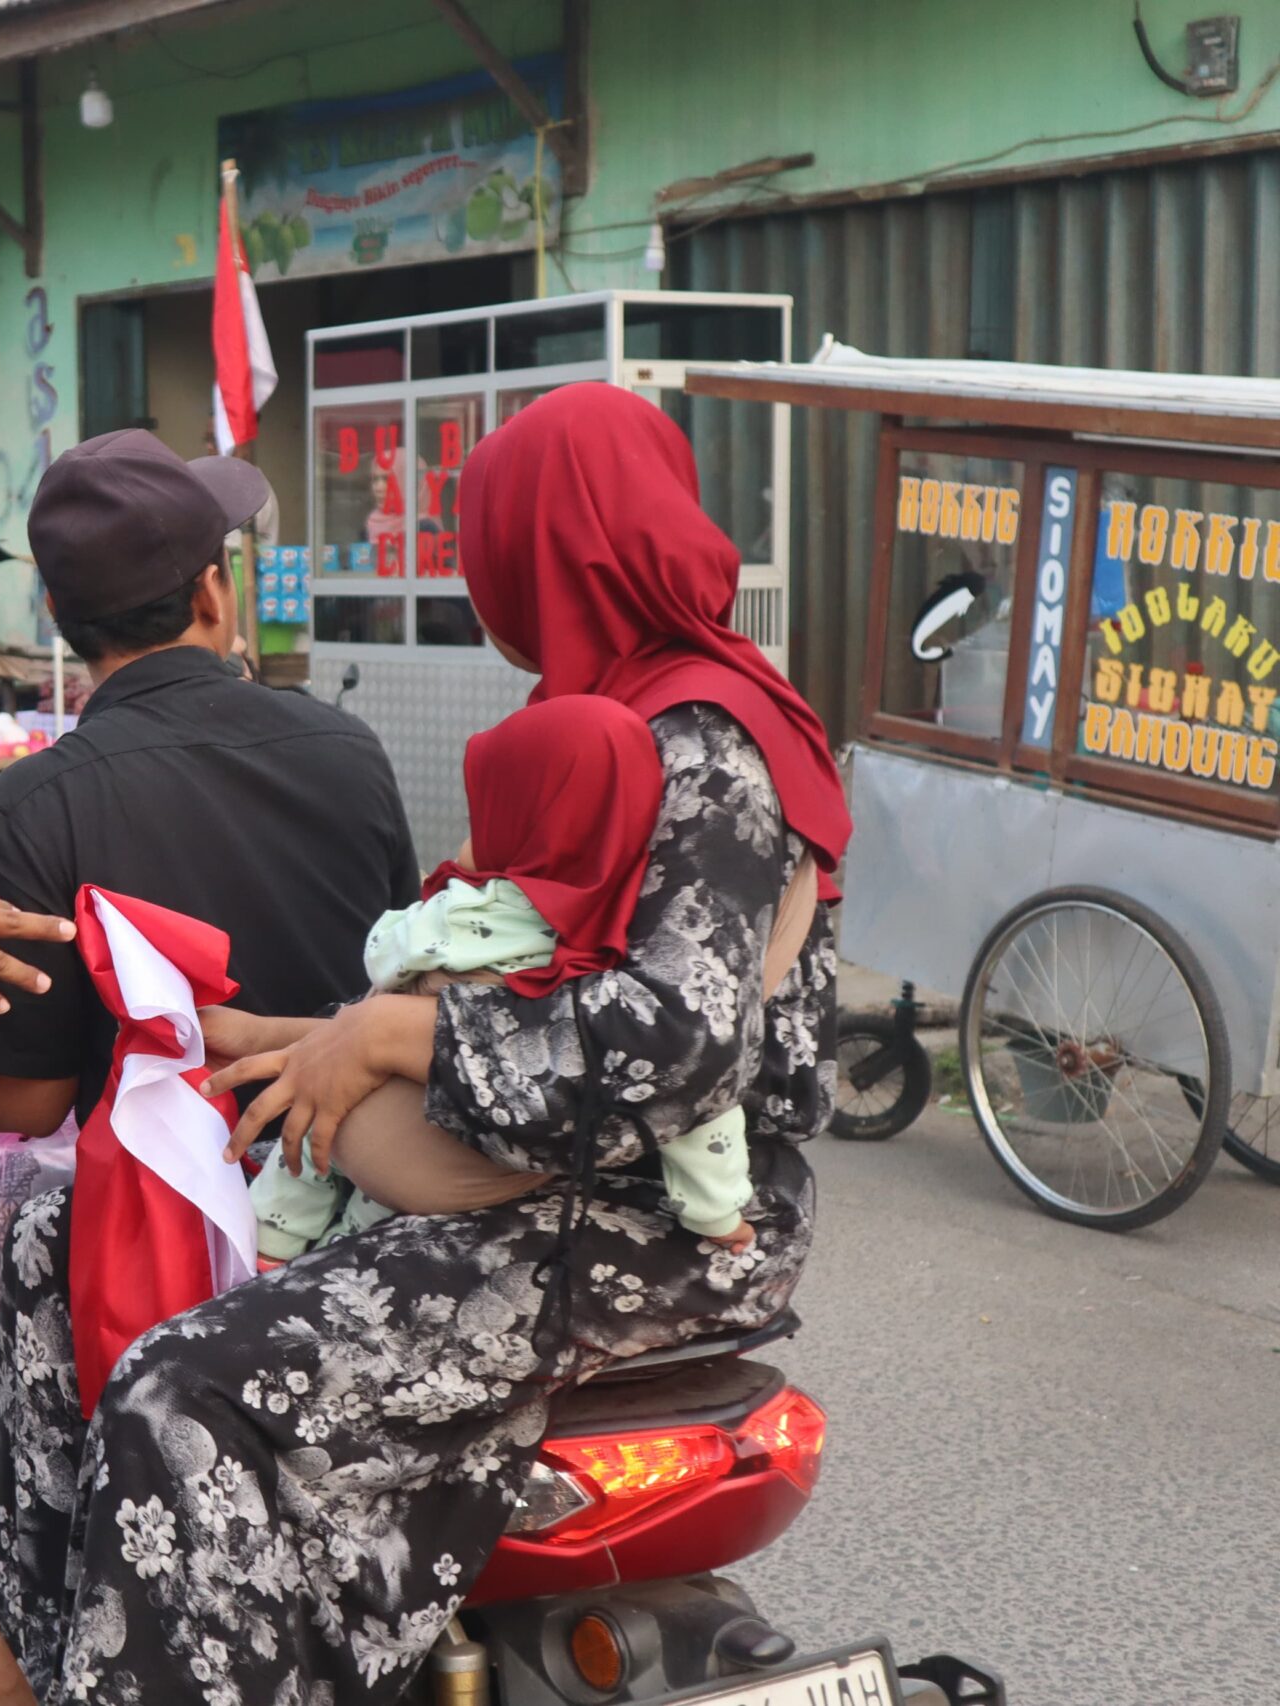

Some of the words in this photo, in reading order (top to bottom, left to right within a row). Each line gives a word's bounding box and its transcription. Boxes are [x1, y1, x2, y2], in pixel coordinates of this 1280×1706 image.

[377, 530, 466, 578] CIRE
[1029, 476, 1071, 740] SIOMAY
[1095, 657, 1277, 732] SIOMAY
[1084, 702, 1279, 790] BANDUNG
